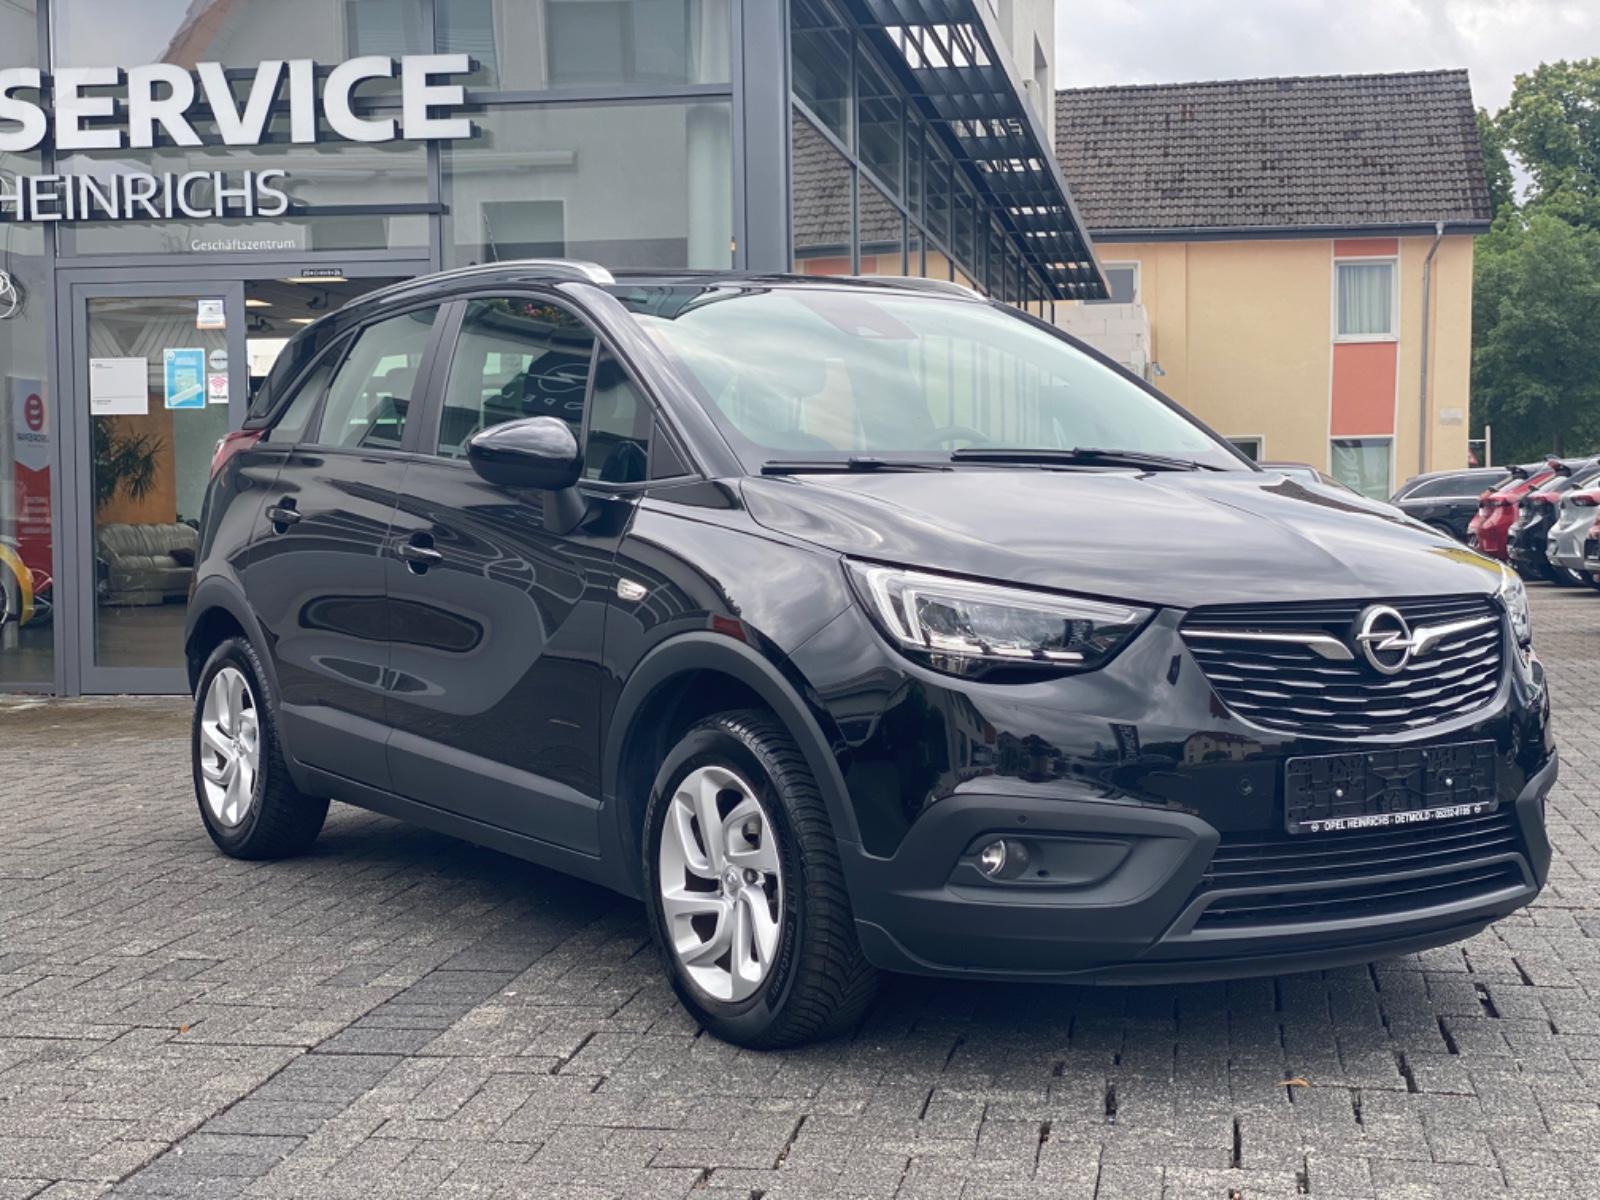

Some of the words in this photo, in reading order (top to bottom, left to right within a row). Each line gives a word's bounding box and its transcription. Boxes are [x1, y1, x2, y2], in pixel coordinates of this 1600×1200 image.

[0, 54, 473, 152] SERVICE
[1324, 818, 1346, 831] OPEL
[1395, 810, 1430, 824] DETMOLD
